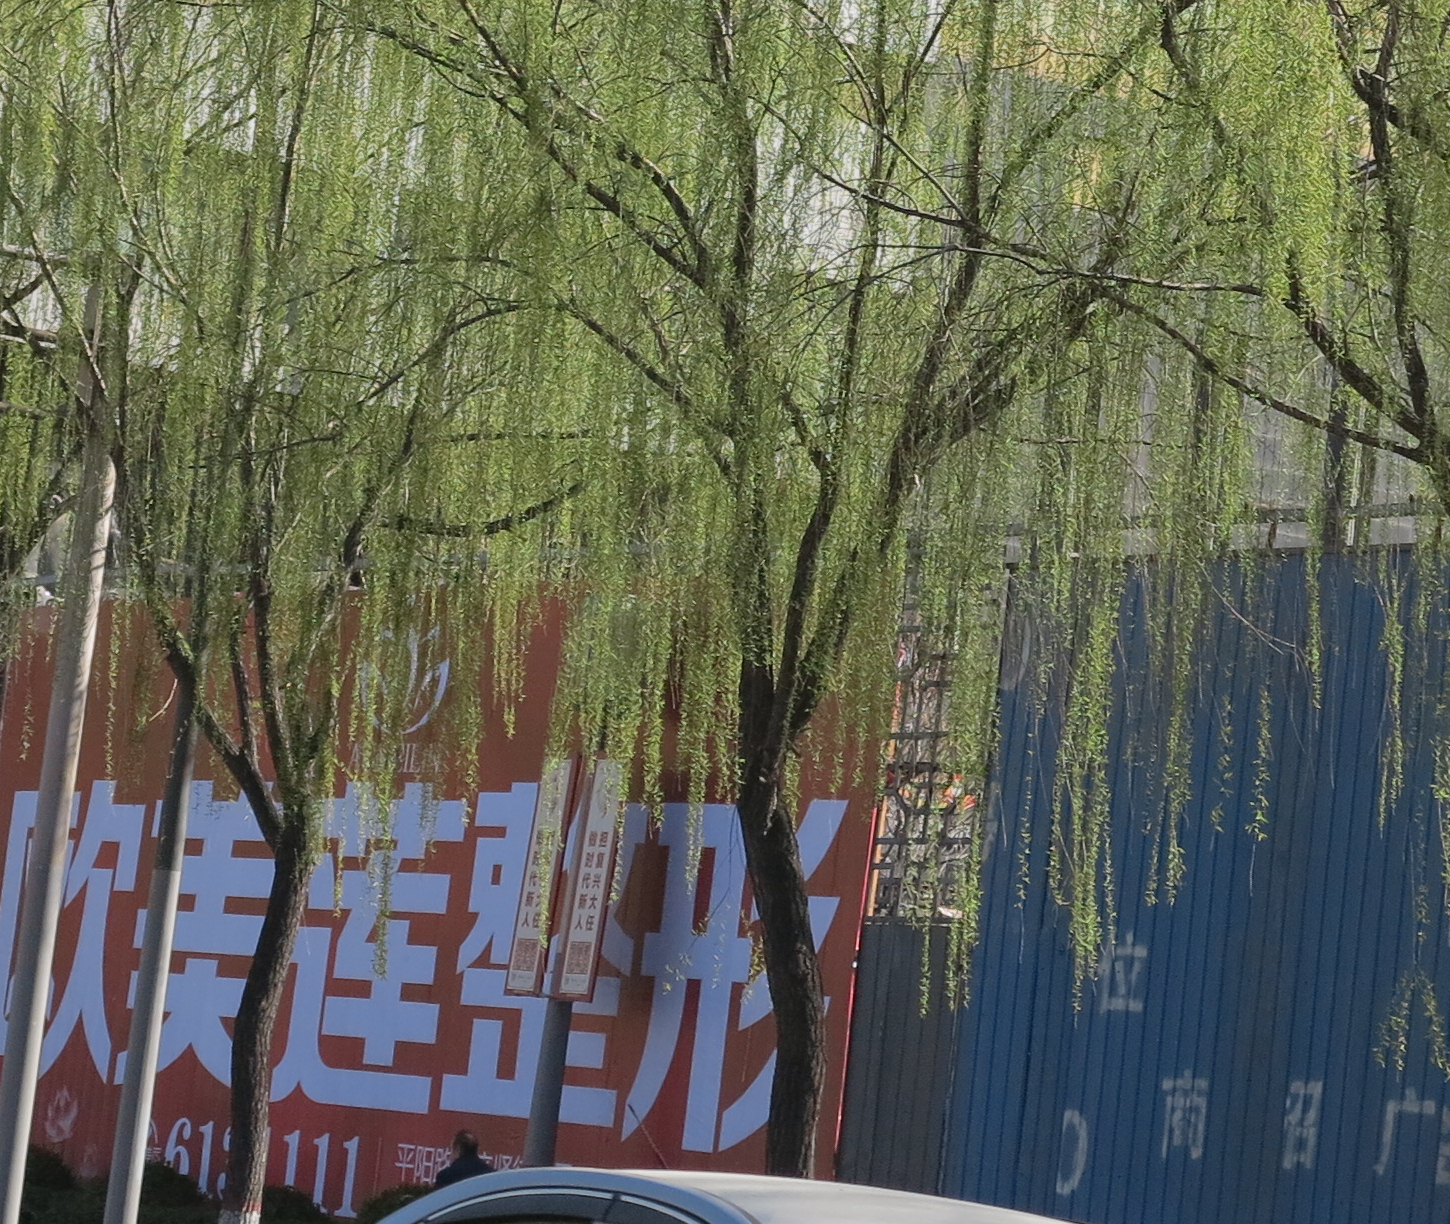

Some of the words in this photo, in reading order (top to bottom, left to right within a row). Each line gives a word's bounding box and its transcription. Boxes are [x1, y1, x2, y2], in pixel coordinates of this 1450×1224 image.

[585, 831, 609, 932] 担复兴大任
